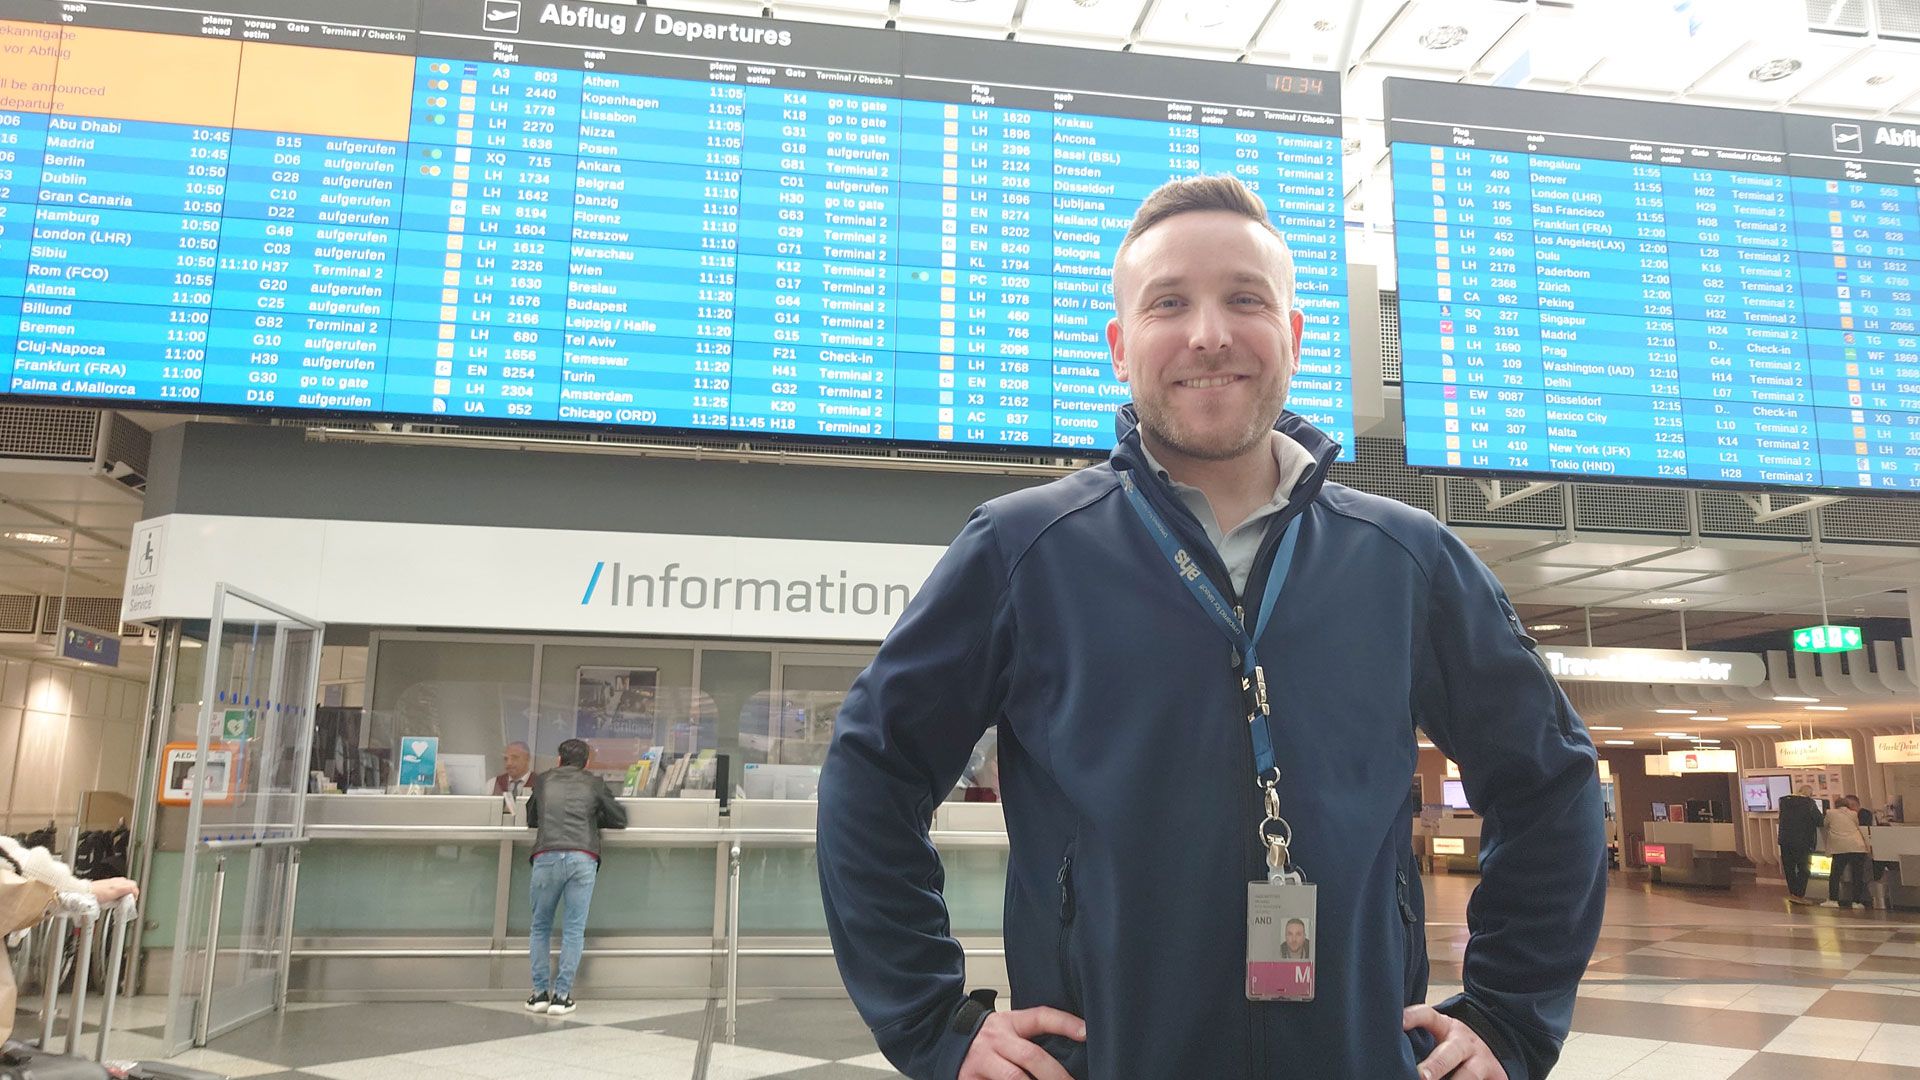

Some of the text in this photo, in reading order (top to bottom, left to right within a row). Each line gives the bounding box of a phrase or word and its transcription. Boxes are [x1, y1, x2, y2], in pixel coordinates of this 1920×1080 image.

[61, 14, 74, 22] to
[202, 16, 233, 26] planm
[201, 27, 231, 36] sched
[286, 23, 310, 33] Gate
[539, 4, 627, 35] Abflug
[654, 14, 792, 47] Departures
[321, 26, 360, 37] Terminal
[368, 30, 407, 41] Check-in
[4, 45, 71, 60] vor Abflug
[11, 80, 106, 96] be announced
[583, 76, 620, 88] Athen
[582, 93, 659, 109] Kopenhagen
[581, 110, 637, 123] Lissabon
[1053, 117, 1094, 130] Krakau
[49, 119, 121, 133] Abu Dhabi
[580, 126, 615, 138] Nizza
[46, 137, 95, 150] Madrid
[192, 130, 230, 143] 10:45
[276, 137, 302, 148] B15
[1276, 137, 1333, 150] Terminal 2
[326, 141, 396, 155] aufgerufen
[578, 143, 618, 156] Posen
[44, 154, 85, 167] Berlin
[485, 153, 552, 168] XQ 715
[577, 160, 622, 173] Ankara
[1529, 158, 1581, 171] Bengaluru
[41, 172, 87, 185] Dublin
[1053, 165, 1102, 178] Dresden
[576, 177, 625, 192] Belgrad
[1530, 173, 1567, 185] Denver
[269, 189, 297, 201] C10
[1053, 181, 1115, 195] Düsseldorf
[38, 190, 133, 207] Gran Canaria
[575, 194, 619, 210] Danzig
[35, 209, 100, 226] Hamburg
[573, 211, 621, 225] Florenz
[1532, 204, 1605, 218] San Francisco
[181, 219, 220, 232] 10:50
[33, 228, 132, 247] London (LHR)
[572, 228, 629, 242] Rzeszow
[1534, 235, 1626, 253] Los Angeles(LAX)
[31, 246, 67, 259] Sibiu
[571, 247, 635, 261] Warschau
[1053, 246, 1101, 261] Bologna
[1535, 251, 1561, 261] Oulu
[28, 264, 109, 282] Rom (FCO)
[220, 259, 289, 273] 11:10 H37
[313, 264, 384, 279] Terminal 2
[569, 264, 603, 276] Wien
[1536, 266, 1591, 279] Paderborn
[25, 284, 76, 296] Atlanta
[568, 281, 617, 295] Breslau
[1537, 282, 1571, 293] Zürich
[22, 302, 72, 316] Billund
[567, 299, 627, 314] Budapest
[1538, 297, 1575, 311] Peking
[1053, 314, 1088, 325] Miami
[1464, 308, 1519, 321] SQ 327
[1540, 314, 1586, 327] Singapur
[19, 321, 75, 335] Bremen
[255, 316, 284, 328] G82
[565, 317, 612, 332] Leipzig
[565, 335, 617, 348] Tel Aviv
[1540, 330, 1577, 341] Madrid
[16, 340, 106, 357] Cluj-Napoca
[165, 349, 205, 361] 11:00
[1542, 346, 1568, 358] Prag
[563, 352, 629, 367] Temeswar
[14, 359, 127, 378] Frankfurt (FRA)
[1543, 362, 1635, 378] Washington (IAD)
[300, 376, 369, 390] go to gate
[562, 371, 596, 383] Turin
[1544, 378, 1572, 388] Delhi
[11, 378, 136, 395] Palma d.Mallorca
[246, 390, 275, 402] D16
[560, 389, 634, 403] Amsterdam
[1469, 390, 1524, 402] EW 9087
[1545, 394, 1602, 406] Düsseldorf
[464, 402, 533, 416] UA 952
[559, 407, 657, 425] Chicago (ORD)
[729, 416, 796, 430] 11:45 H18
[1546, 411, 1608, 425] Mexico City
[1547, 427, 1578, 438] Malta
[1052, 433, 1095, 447] Zagreb
[1549, 443, 1631, 458] New York (JFK)
[1550, 459, 1615, 474] Tokio (HND)
[1720, 469, 1742, 479] H28
[1759, 471, 1813, 482] Terminal 2
[1295, 965, 1310, 983] M
